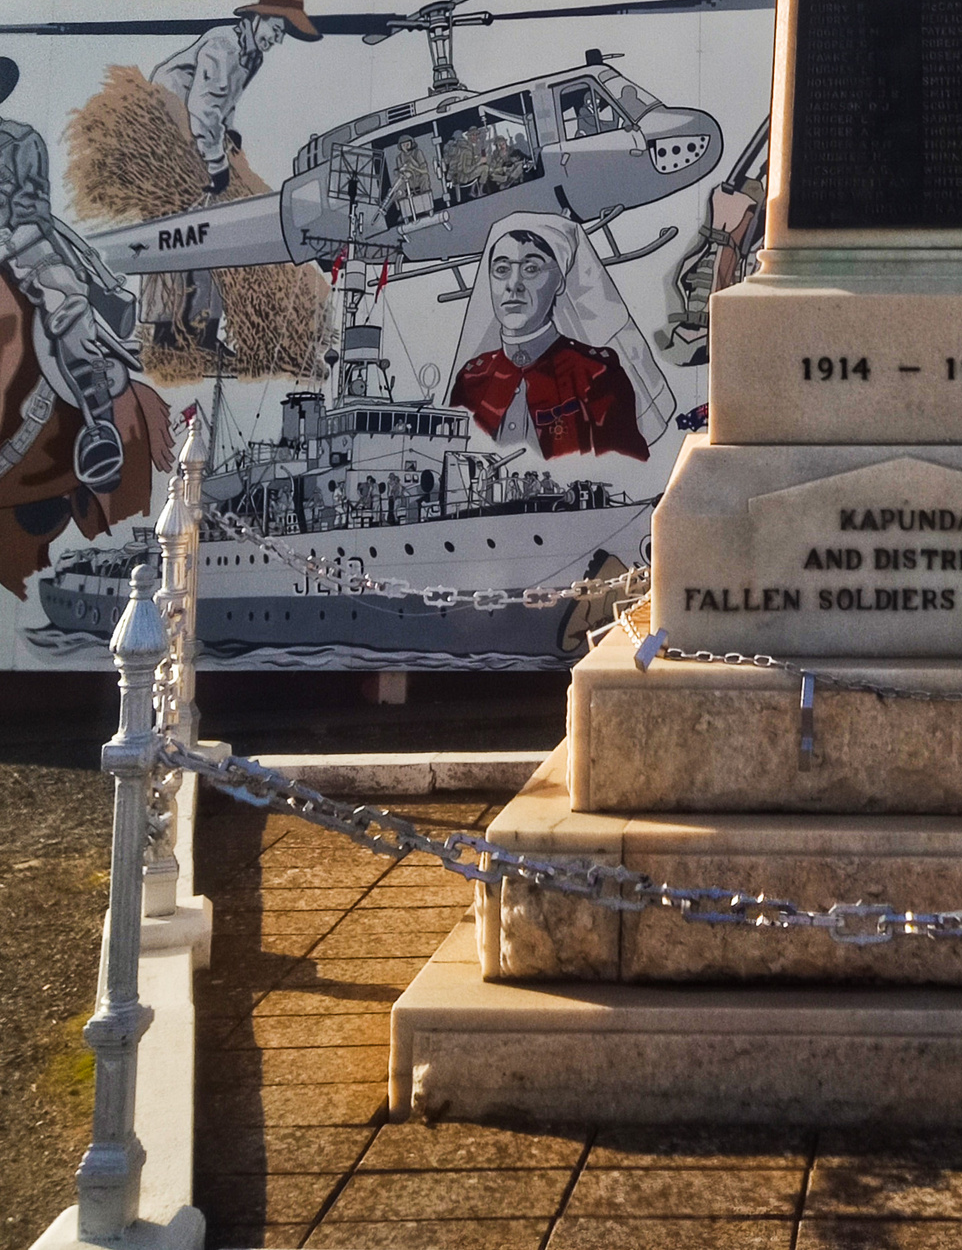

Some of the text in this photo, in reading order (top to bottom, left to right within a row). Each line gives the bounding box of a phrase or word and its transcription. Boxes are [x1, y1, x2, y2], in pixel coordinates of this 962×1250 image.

[158, 222, 210, 250] RAAF
[801, 357, 871, 381] 1914
[804, 549, 863, 571] AND
[684, 587, 802, 612] FALLEN
[818, 588, 956, 612] SOLDIERS
